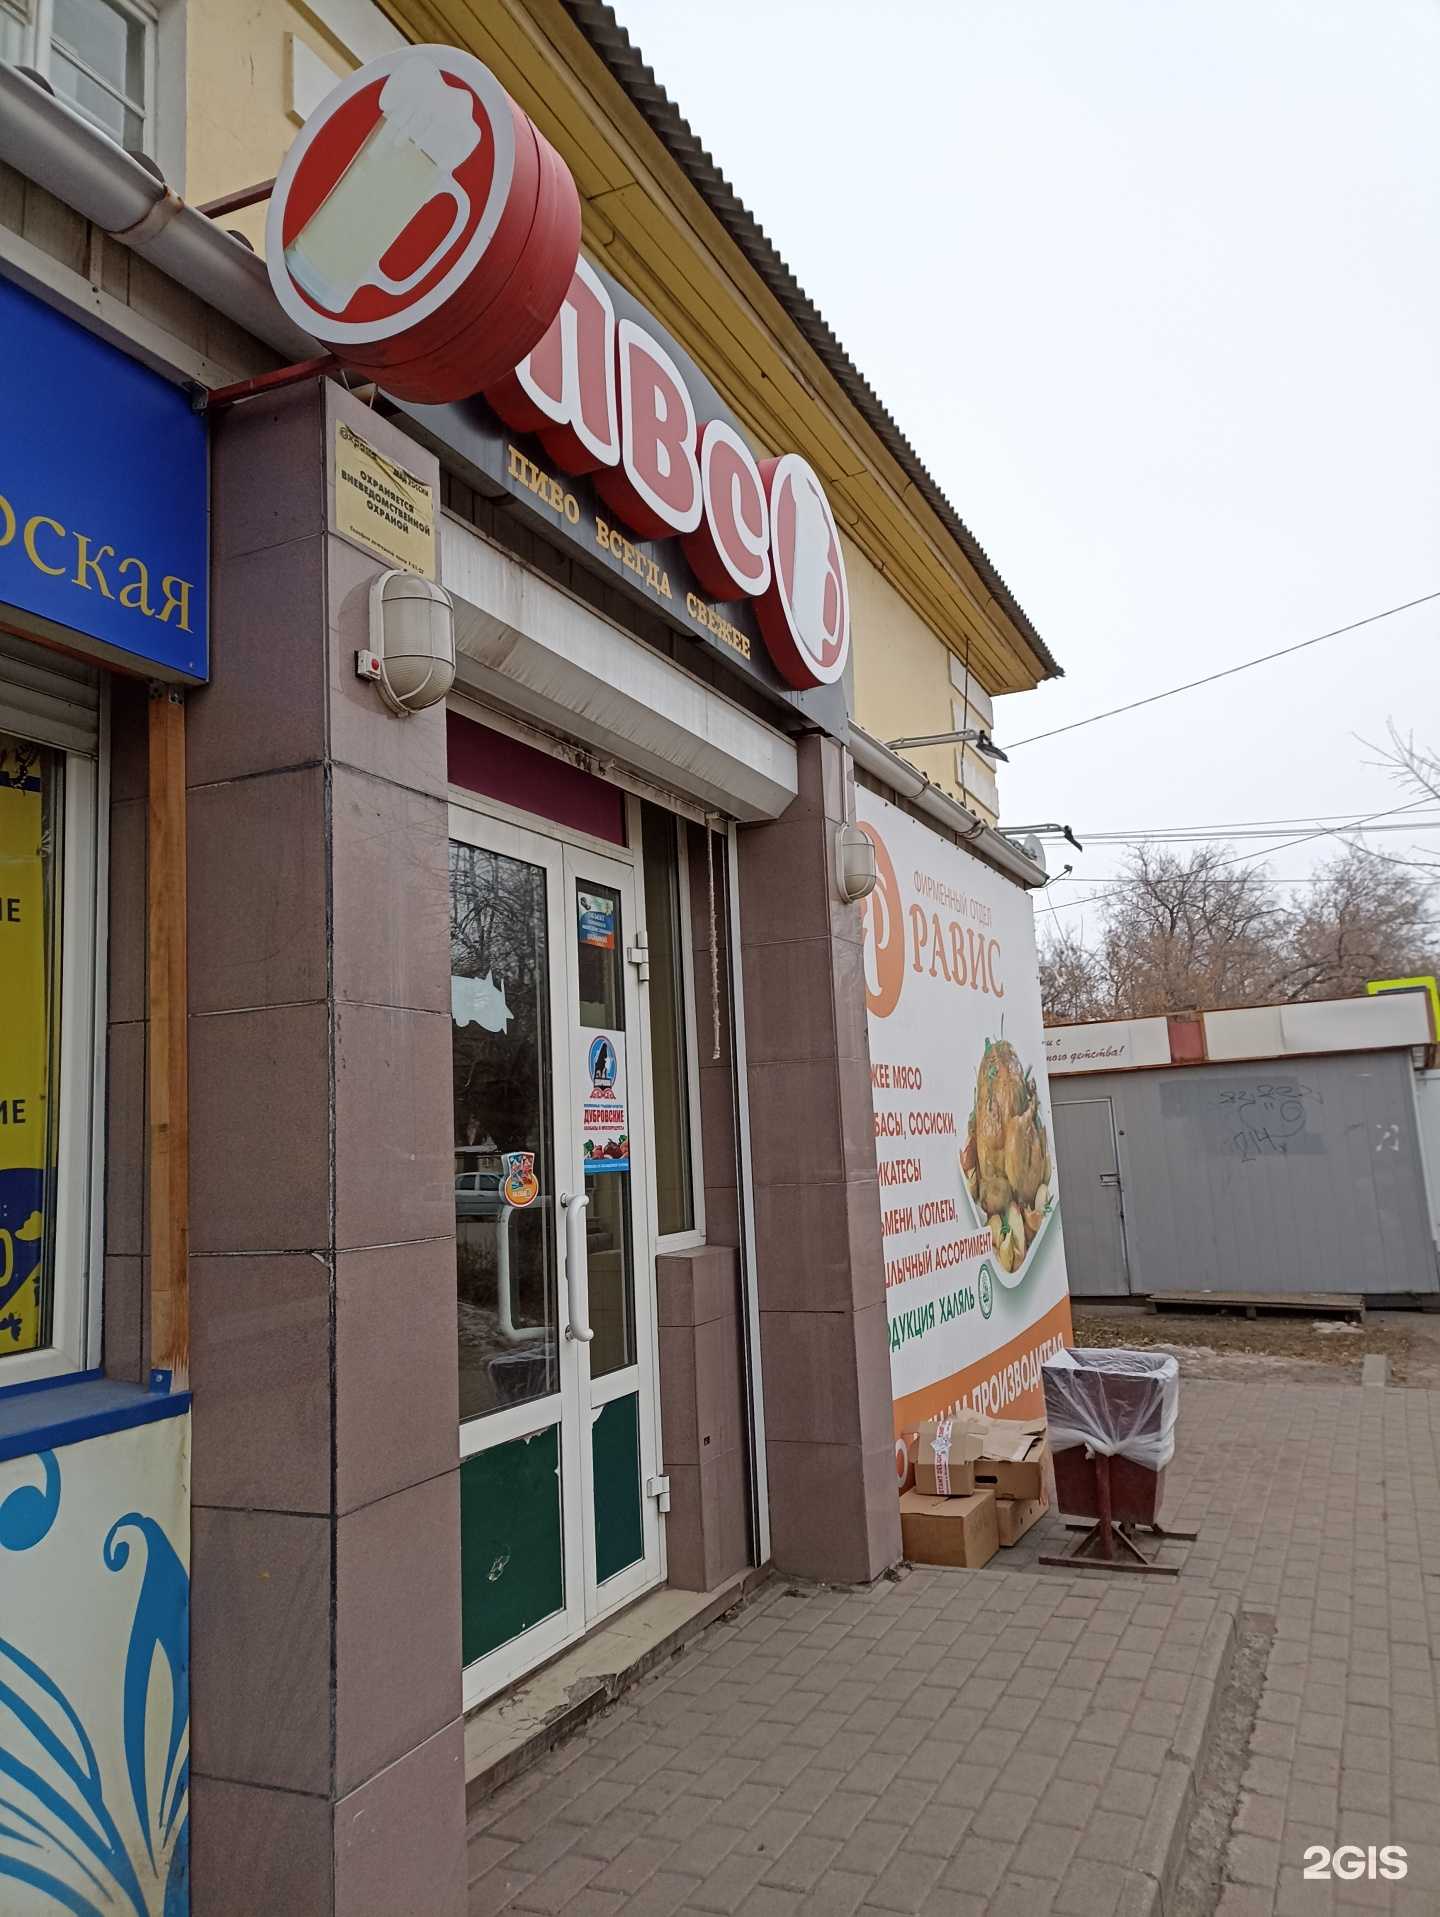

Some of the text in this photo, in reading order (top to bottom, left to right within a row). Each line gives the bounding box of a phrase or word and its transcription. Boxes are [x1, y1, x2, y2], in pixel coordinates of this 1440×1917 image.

[341, 469, 431, 537] ВНЕВЕДОМСТВЕННОЙ
[360, 470, 415, 513] ОХРАНЯЕТСЯ
[366, 499, 409, 535] ОХРАНОЙ
[508, 444, 751, 661] ПИВО ВСЕГДА СВЕЖЕЕ
[913, 870, 993, 929] ФИРМЕННЫЙ ОТДЕЛ
[909, 903, 1005, 998] РАВИС
[892, 1064, 922, 1090] МЯСО
[584, 1109, 625, 1124] ДУБРОВСКИЕ
[908, 1111, 957, 1137] СОСИСКИ,
[918, 1199, 959, 1228] КОТЛЕТЫ,
[935, 1231, 993, 1271] АССОРТИМЕНТ
[938, 1285, 975, 1325] ХАЛЯЛЬ
